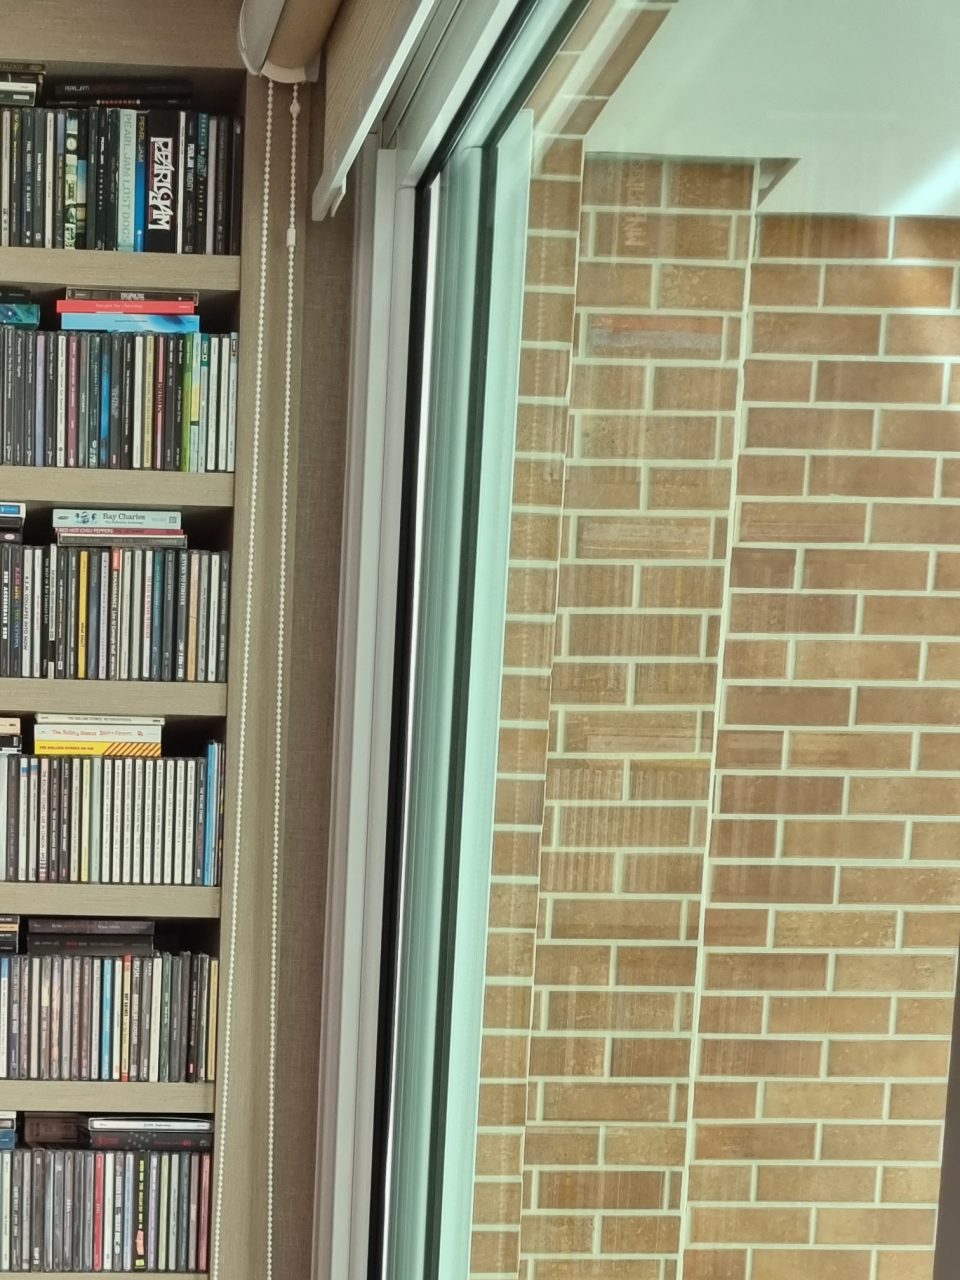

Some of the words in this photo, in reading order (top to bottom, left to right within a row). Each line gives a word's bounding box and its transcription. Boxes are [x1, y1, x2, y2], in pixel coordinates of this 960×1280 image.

[124, 114, 132, 151] PEARL
[123, 153, 131, 177] JAM
[122, 179, 130, 208] LOST
[122, 212, 130, 242] DOGS
